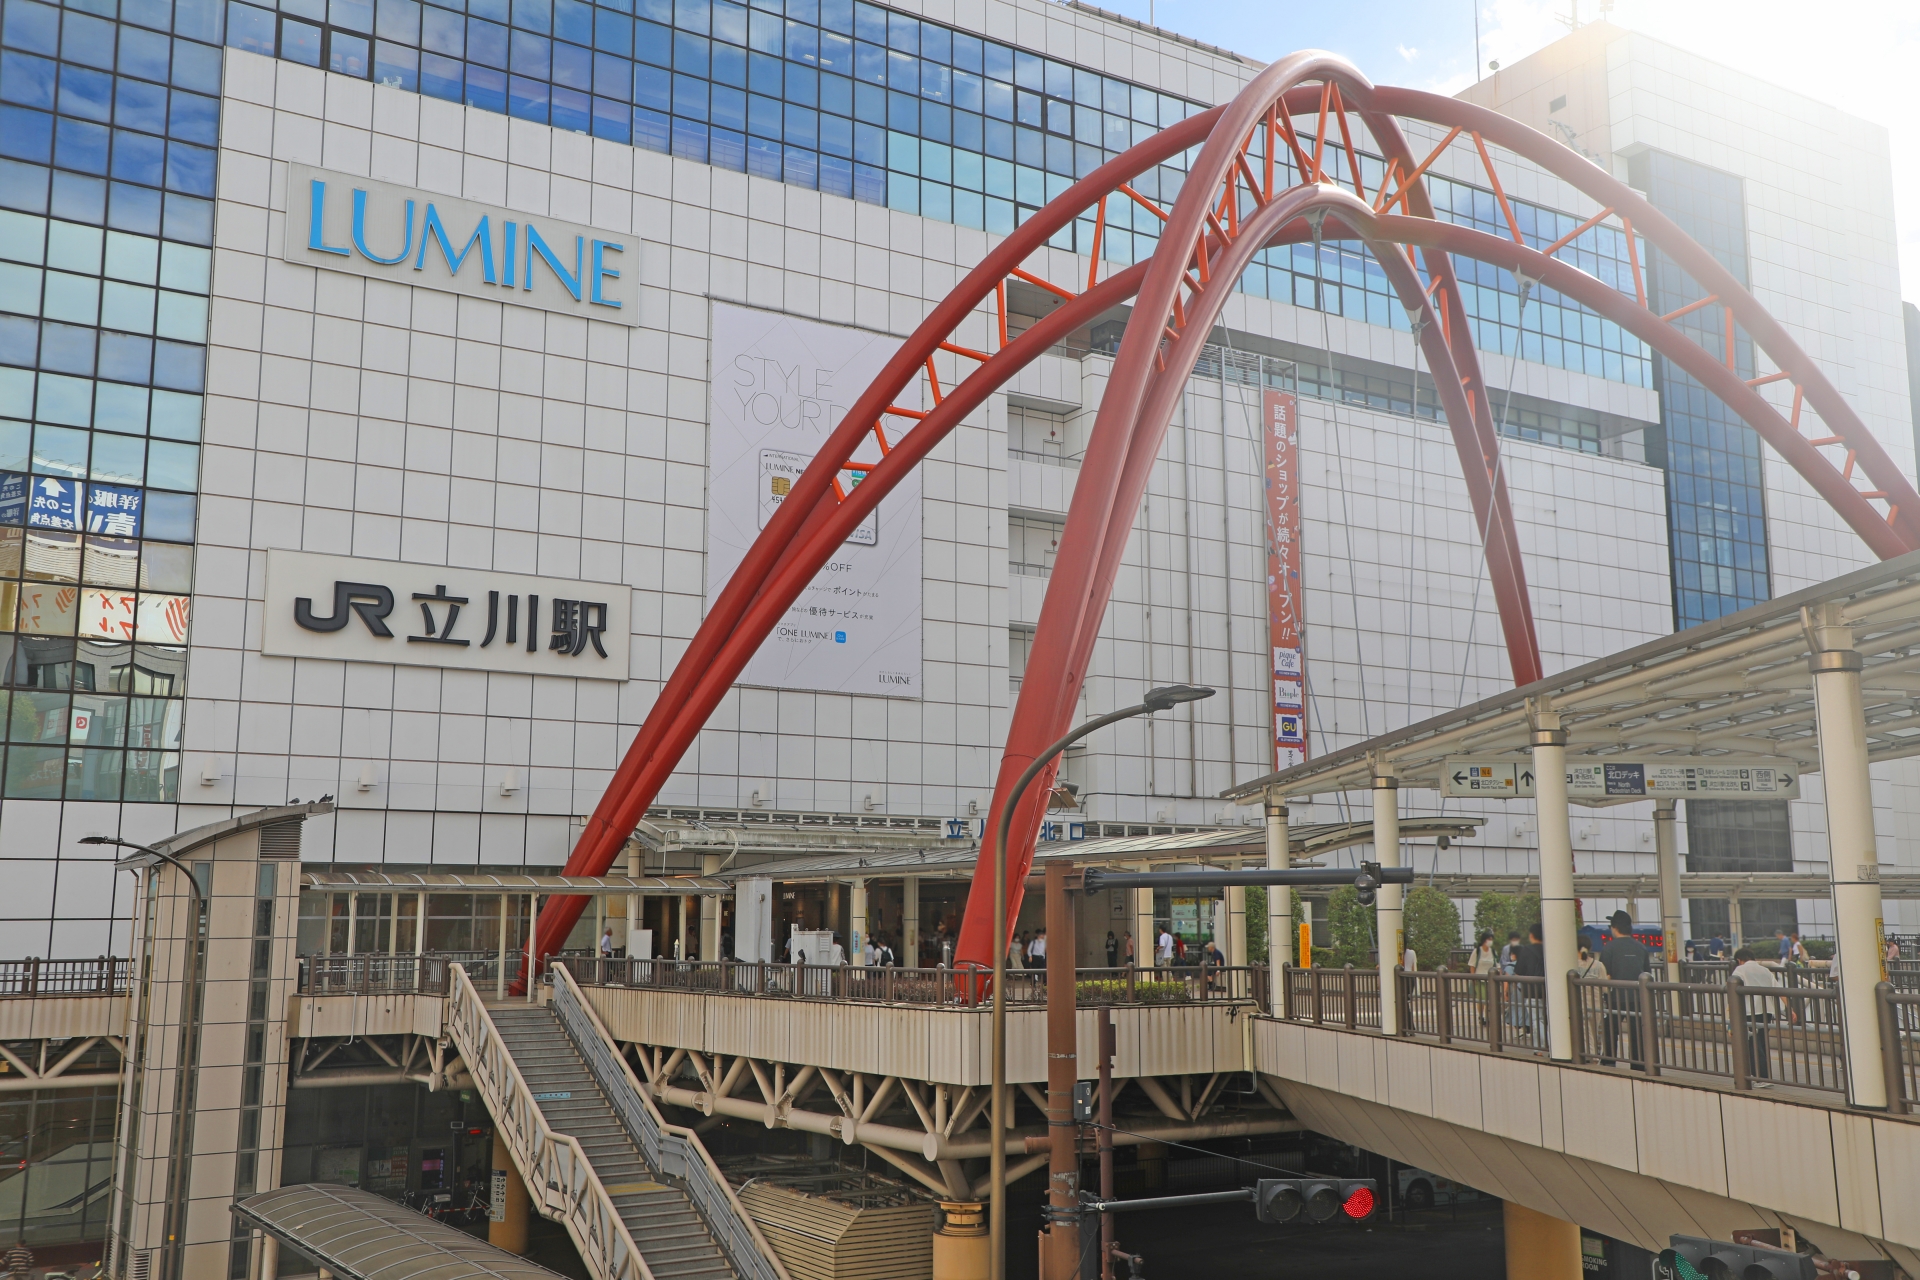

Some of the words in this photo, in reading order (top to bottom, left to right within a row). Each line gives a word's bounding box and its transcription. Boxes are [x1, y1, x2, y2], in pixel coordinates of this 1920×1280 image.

[308, 179, 624, 308] LUMINE
[734, 354, 833, 402] STYLE
[734, 387, 820, 434] YOUR
[829, 404, 905, 446] DS
[766, 463, 793, 473] LUMINE
[1279, 651, 1296, 660] pique
[879, 674, 911, 685] LUMINE
[1283, 722, 1296, 732] GU
[1608, 771, 1640, 779] 北口デッキ
